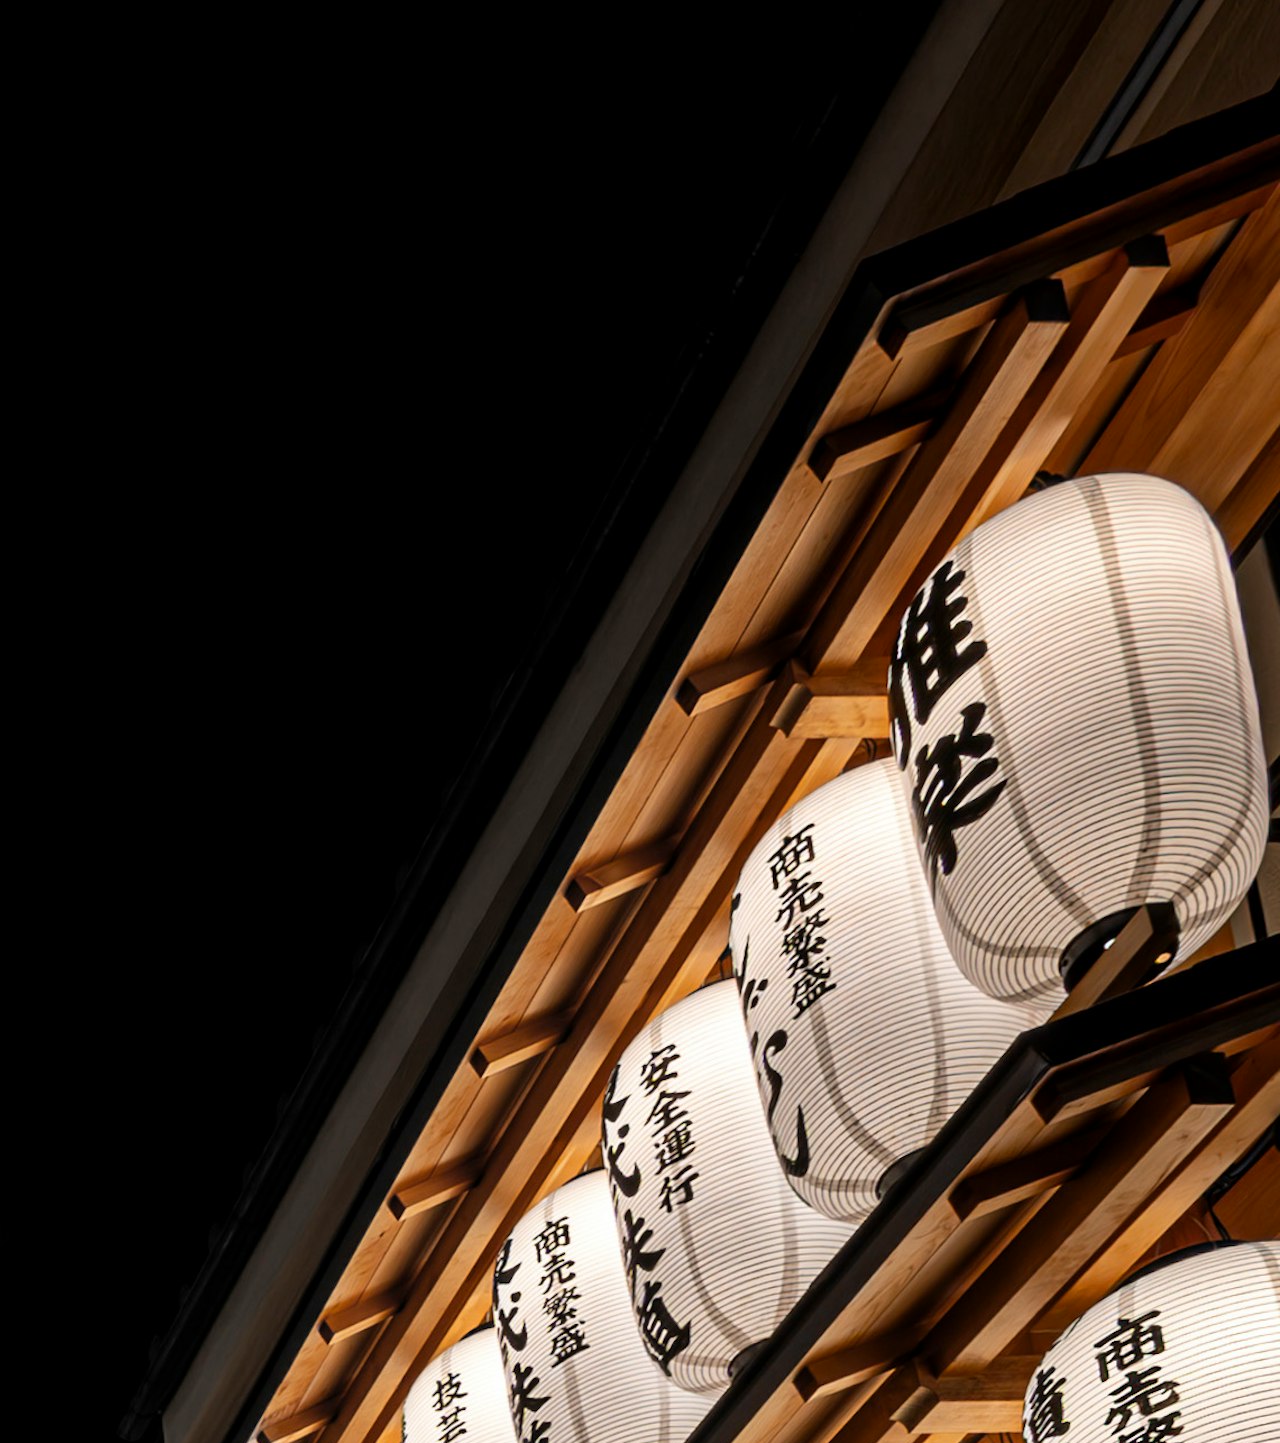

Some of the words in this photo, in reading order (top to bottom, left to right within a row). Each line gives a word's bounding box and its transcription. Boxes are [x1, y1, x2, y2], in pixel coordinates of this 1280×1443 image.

[767, 823, 837, 1021] 商売繁盛
[640, 1042, 699, 1216] 安全運行
[532, 1214, 591, 1369] 商売繁盛
